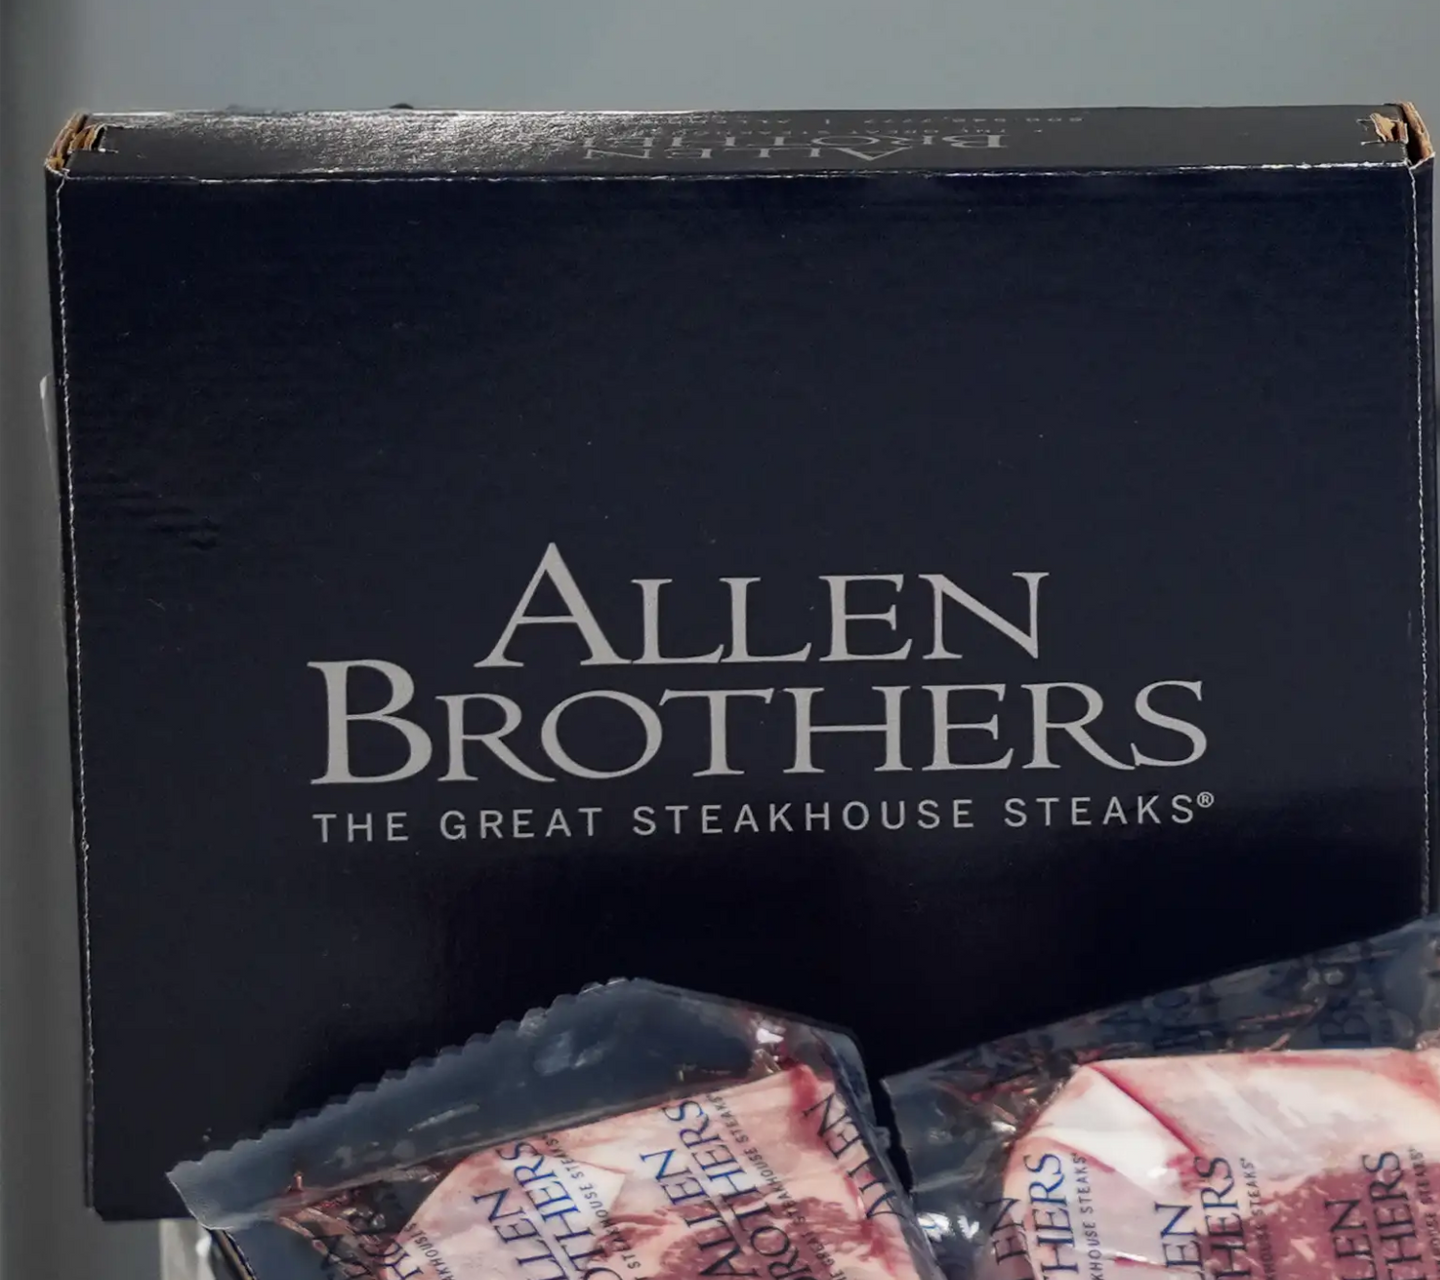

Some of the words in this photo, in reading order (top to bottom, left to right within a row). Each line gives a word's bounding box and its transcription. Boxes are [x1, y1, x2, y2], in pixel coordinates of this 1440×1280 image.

[474, 542, 1049, 668] ALLEN
[307, 659, 1207, 784] BROTHERS
[312, 813, 408, 843] THE
[440, 807, 603, 840] GREAT
[632, 799, 974, 836] STEAKHOUSE
[641, 1148, 762, 1278] ALLEN
